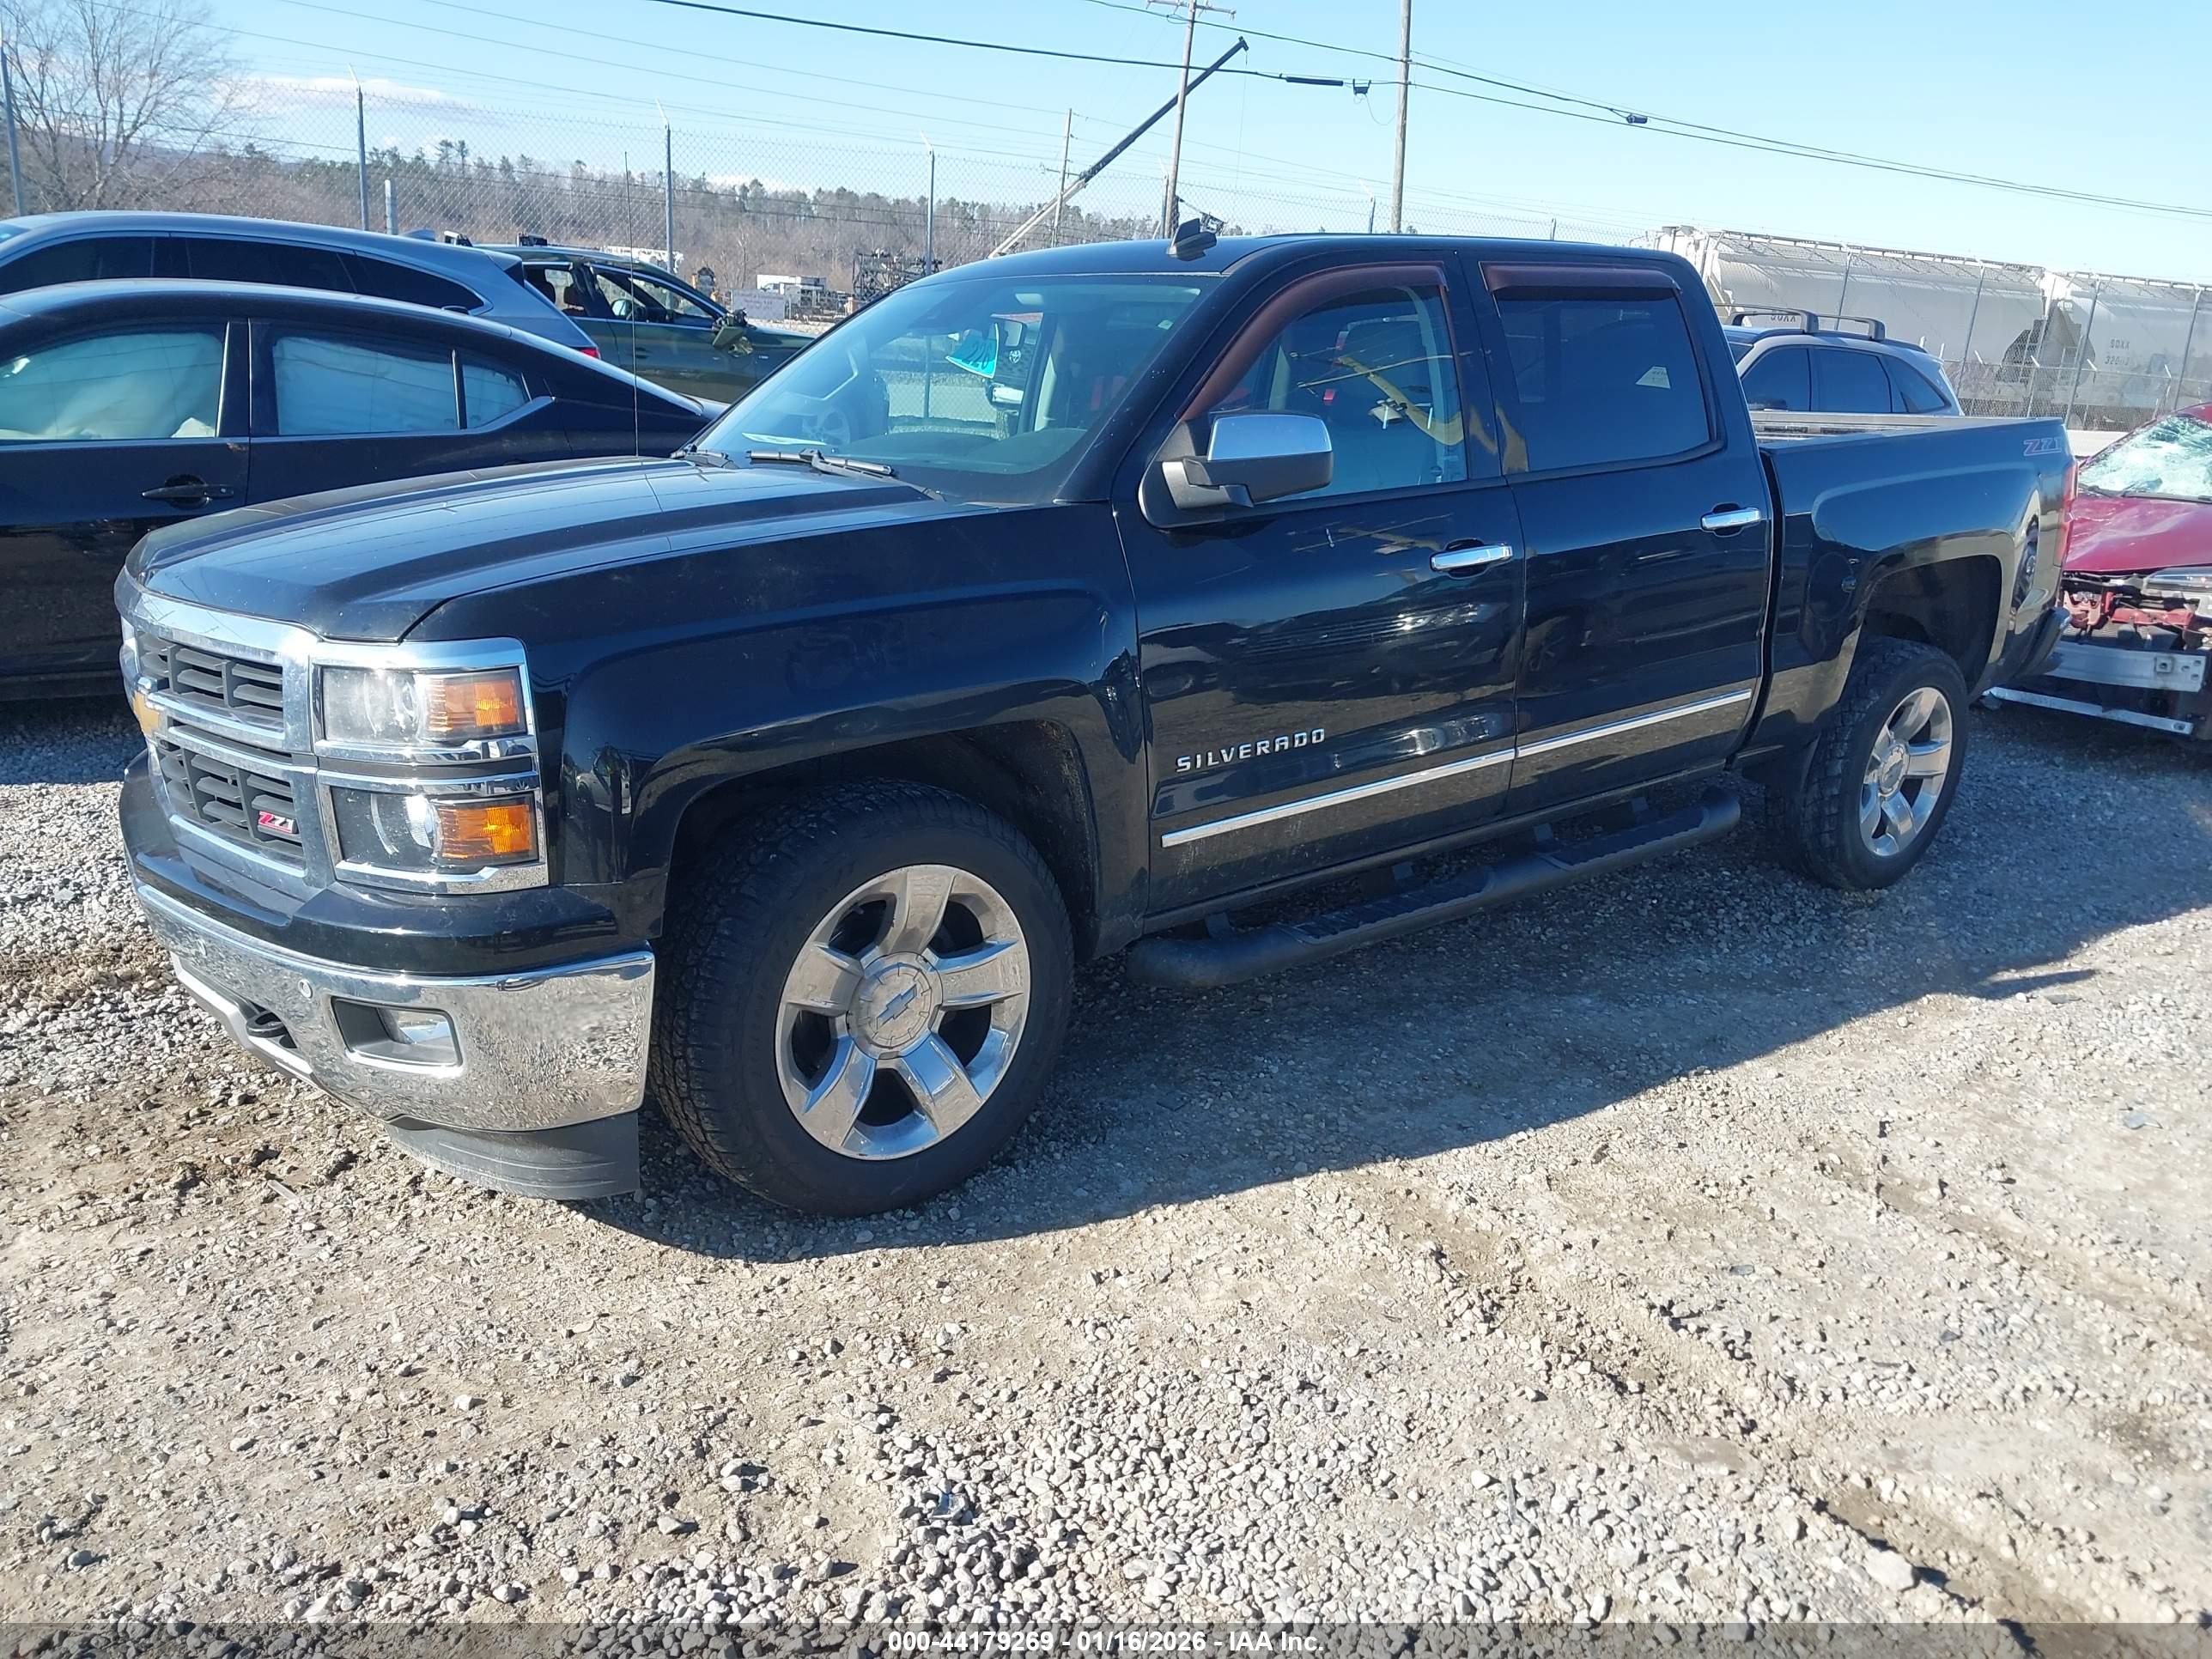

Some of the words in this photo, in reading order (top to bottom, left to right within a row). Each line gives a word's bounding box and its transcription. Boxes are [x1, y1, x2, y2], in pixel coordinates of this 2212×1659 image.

[2023, 436, 2062, 457] Z71
[1176, 728, 1325, 772] SILVERADO
[258, 811, 294, 834] Z71
